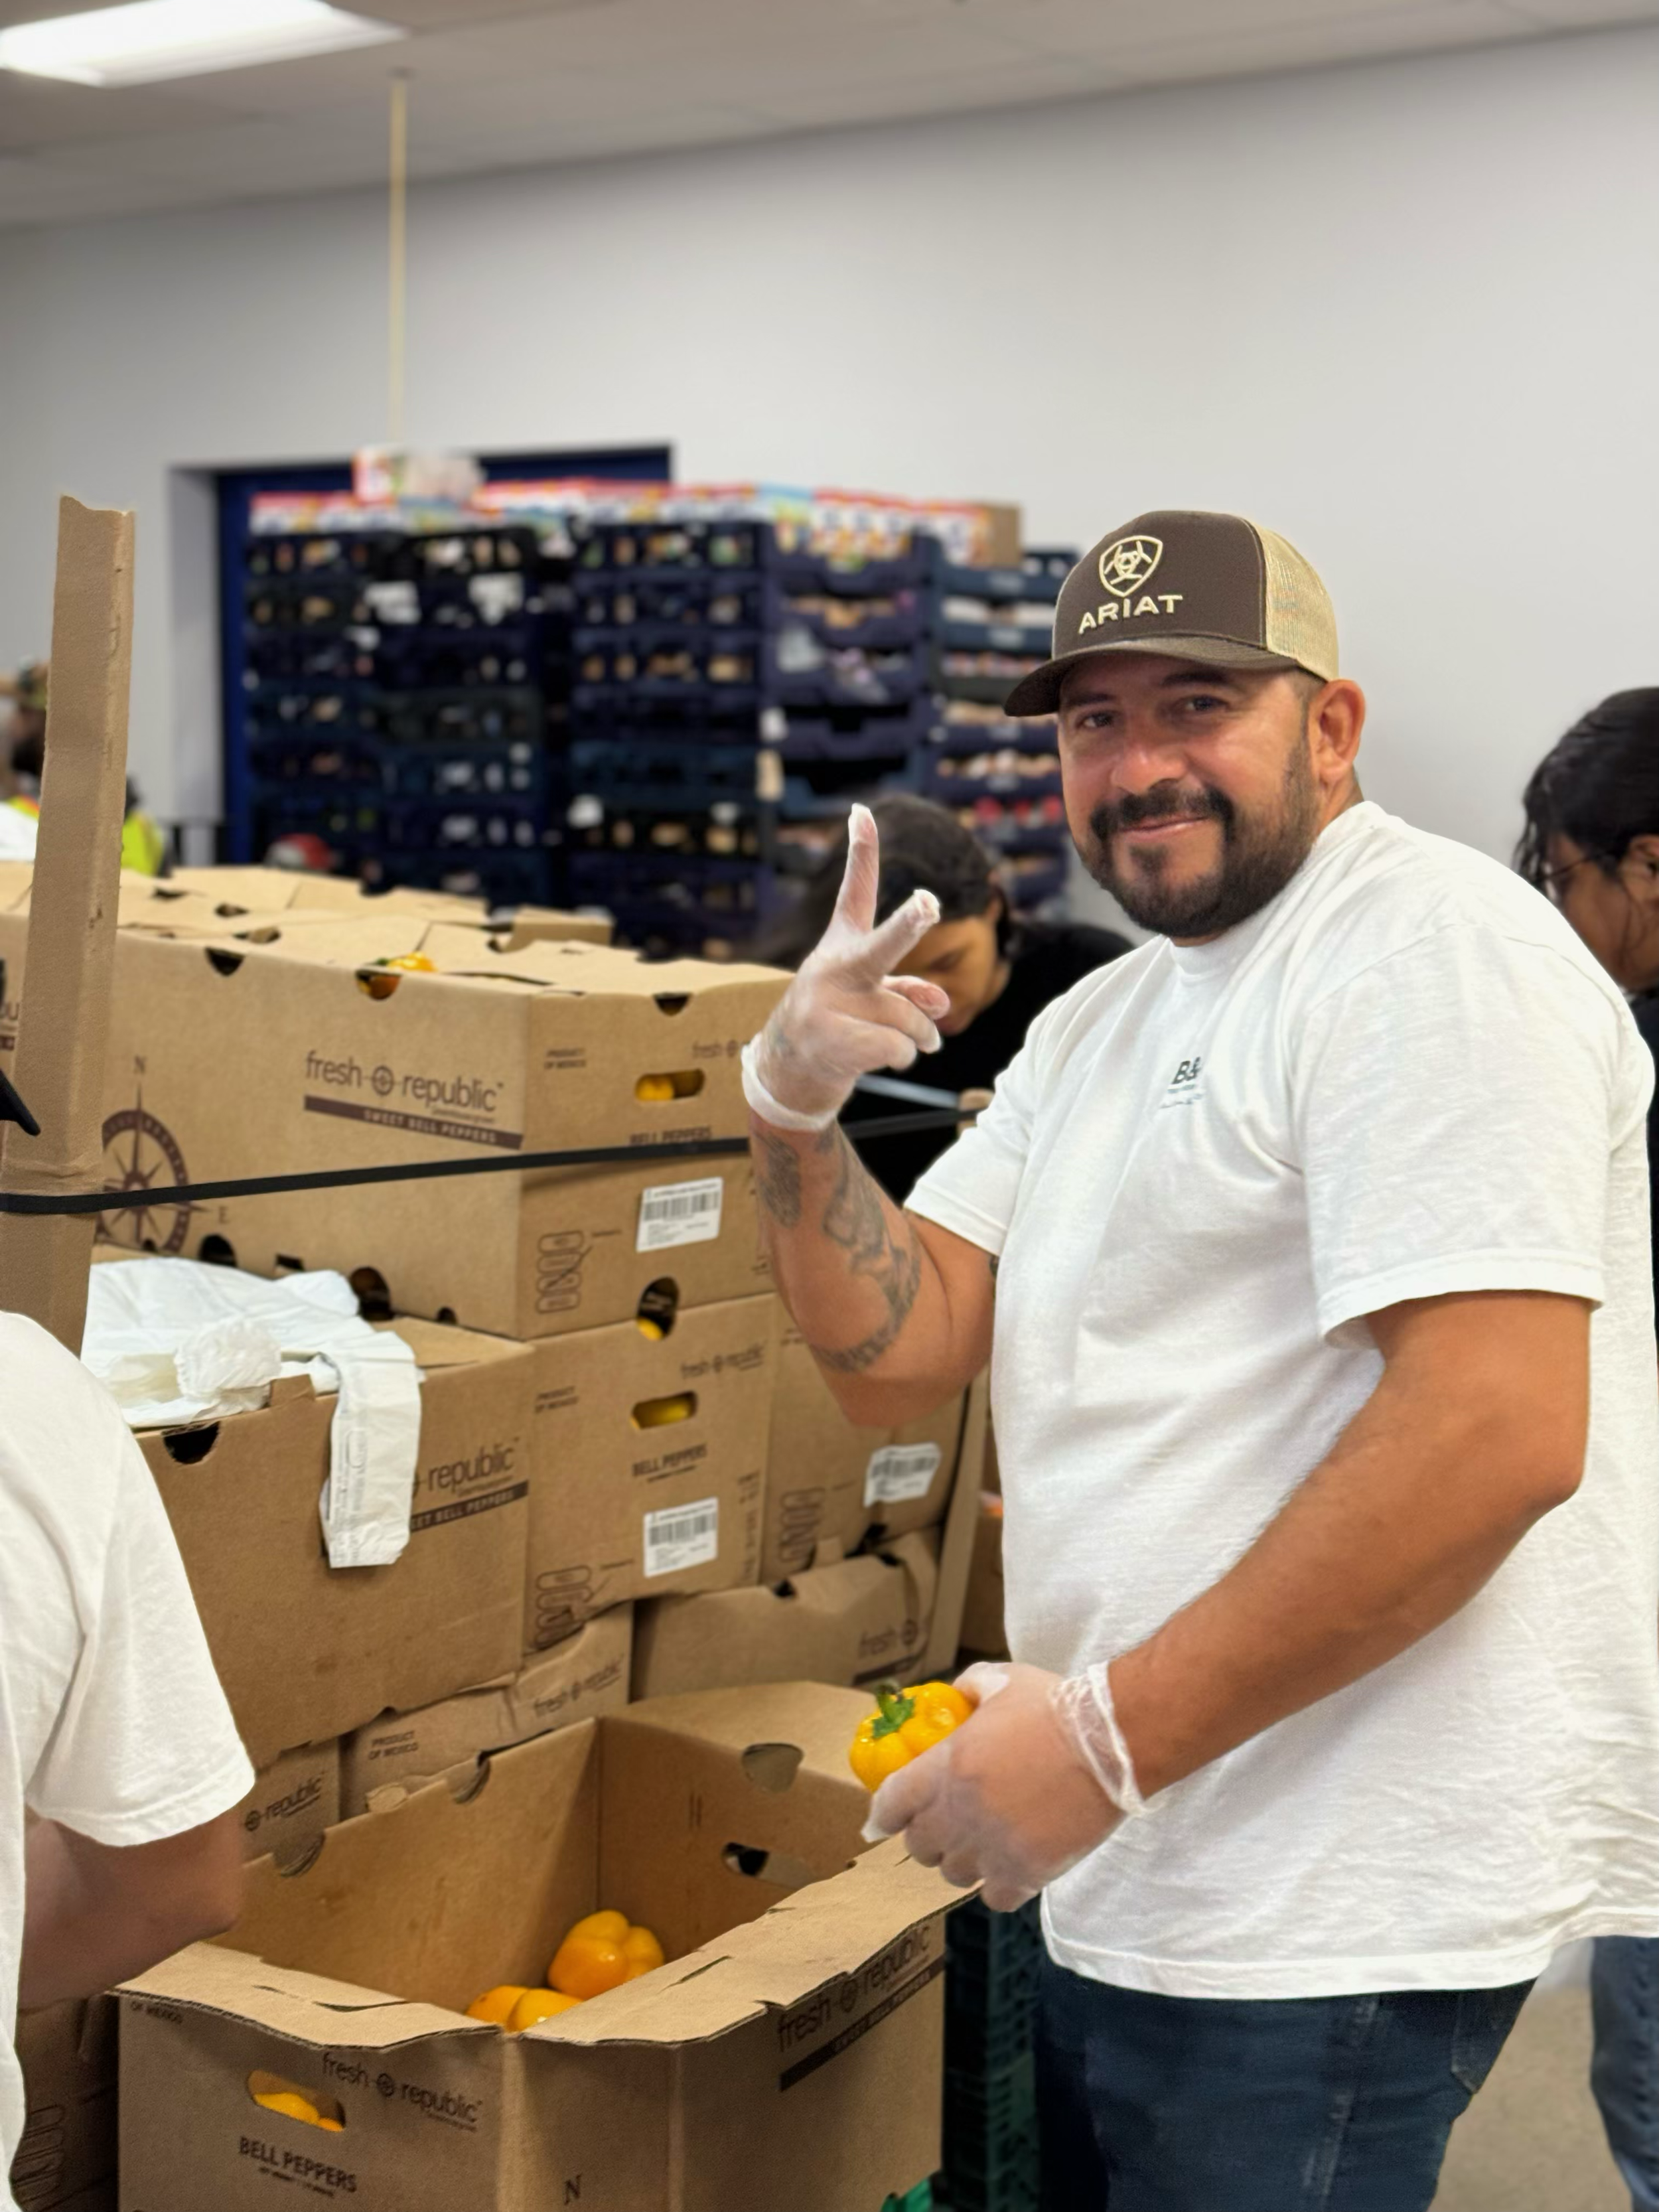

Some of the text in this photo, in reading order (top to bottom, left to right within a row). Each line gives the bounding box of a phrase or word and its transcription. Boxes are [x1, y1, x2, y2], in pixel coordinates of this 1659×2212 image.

[1078, 595, 1183, 635] ARIAT
[306, 1049, 496, 1112] fresh republic
[365, 1110, 498, 1143] SWEET BELL PEPPERS
[428, 1443, 514, 1493] republic
[323, 2051, 370, 2087] fresh
[401, 2083, 478, 2123] republic
[239, 2136, 279, 2166] BELL
[283, 2150, 358, 2193] PEPPERS
[563, 2172, 583, 2206] N
